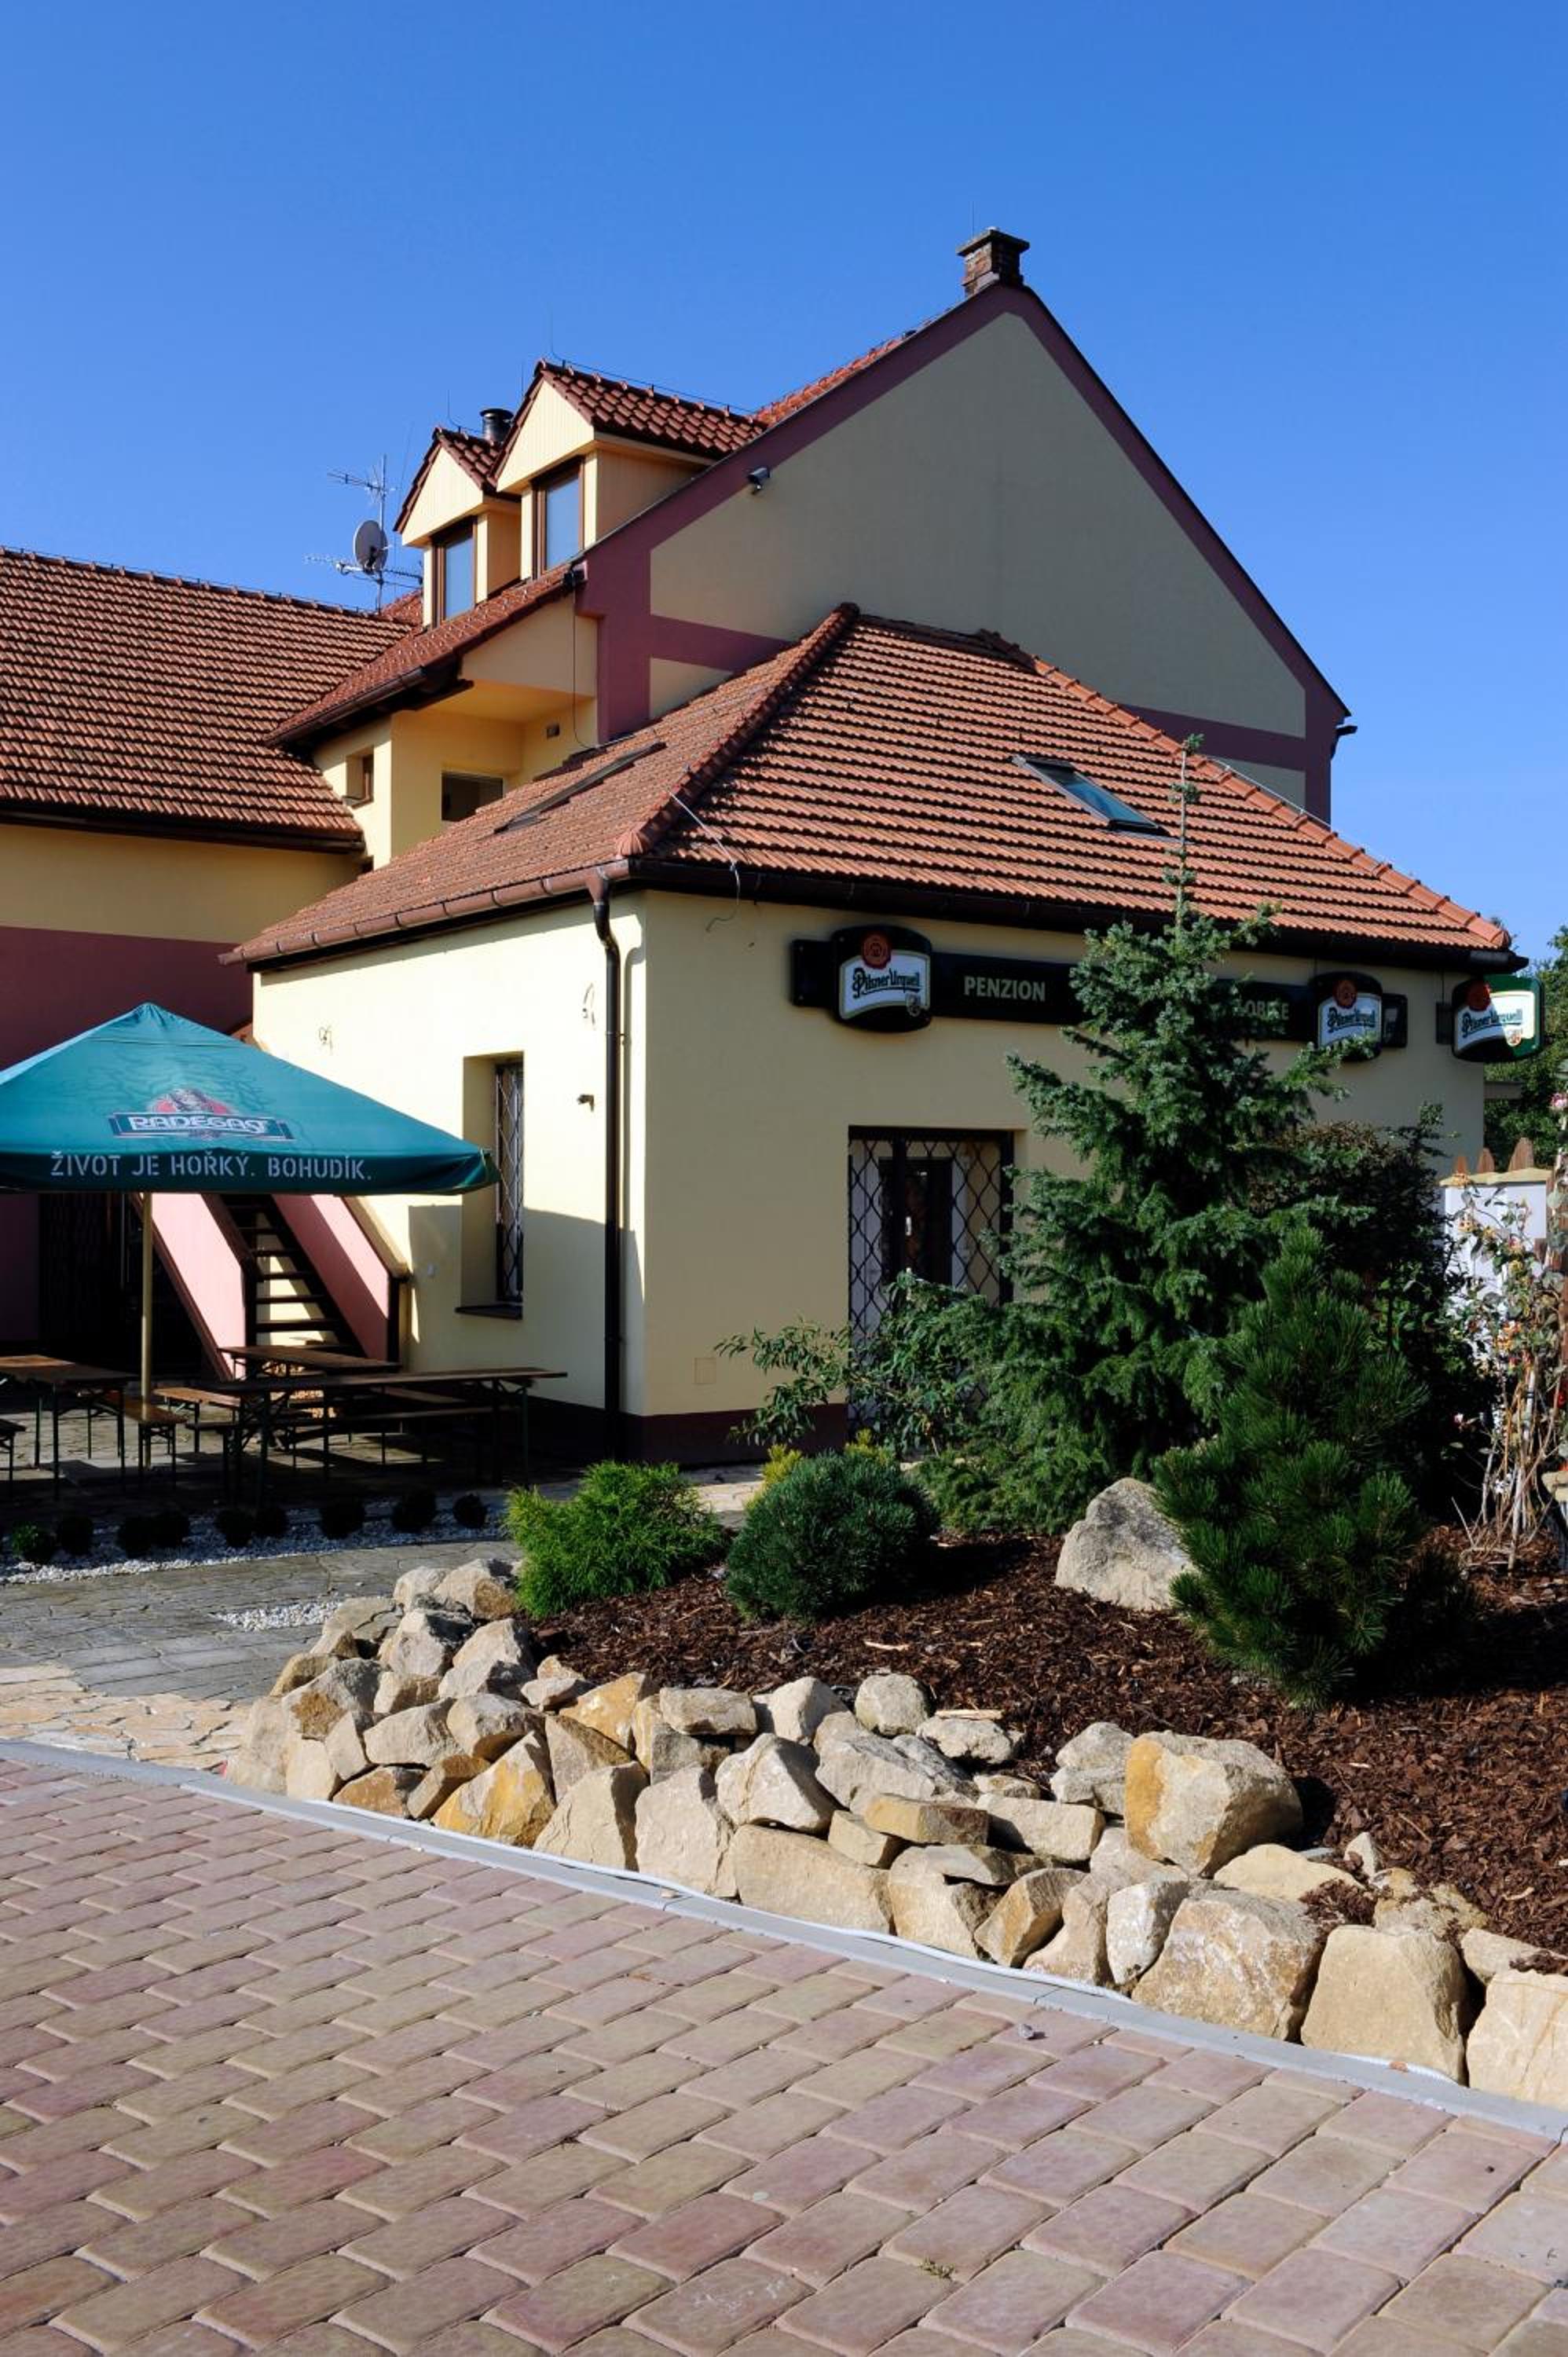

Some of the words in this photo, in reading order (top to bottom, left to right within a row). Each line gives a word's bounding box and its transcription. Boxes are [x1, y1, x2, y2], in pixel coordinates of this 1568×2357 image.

[963, 975, 1046, 1003] PENZION
[50, 1150, 120, 1177] ŽIVOT
[131, 1154, 159, 1176] JE
[170, 1150, 256, 1177] HOŘKÝ.
[267, 1156, 372, 1180] BOHUDÍK.
